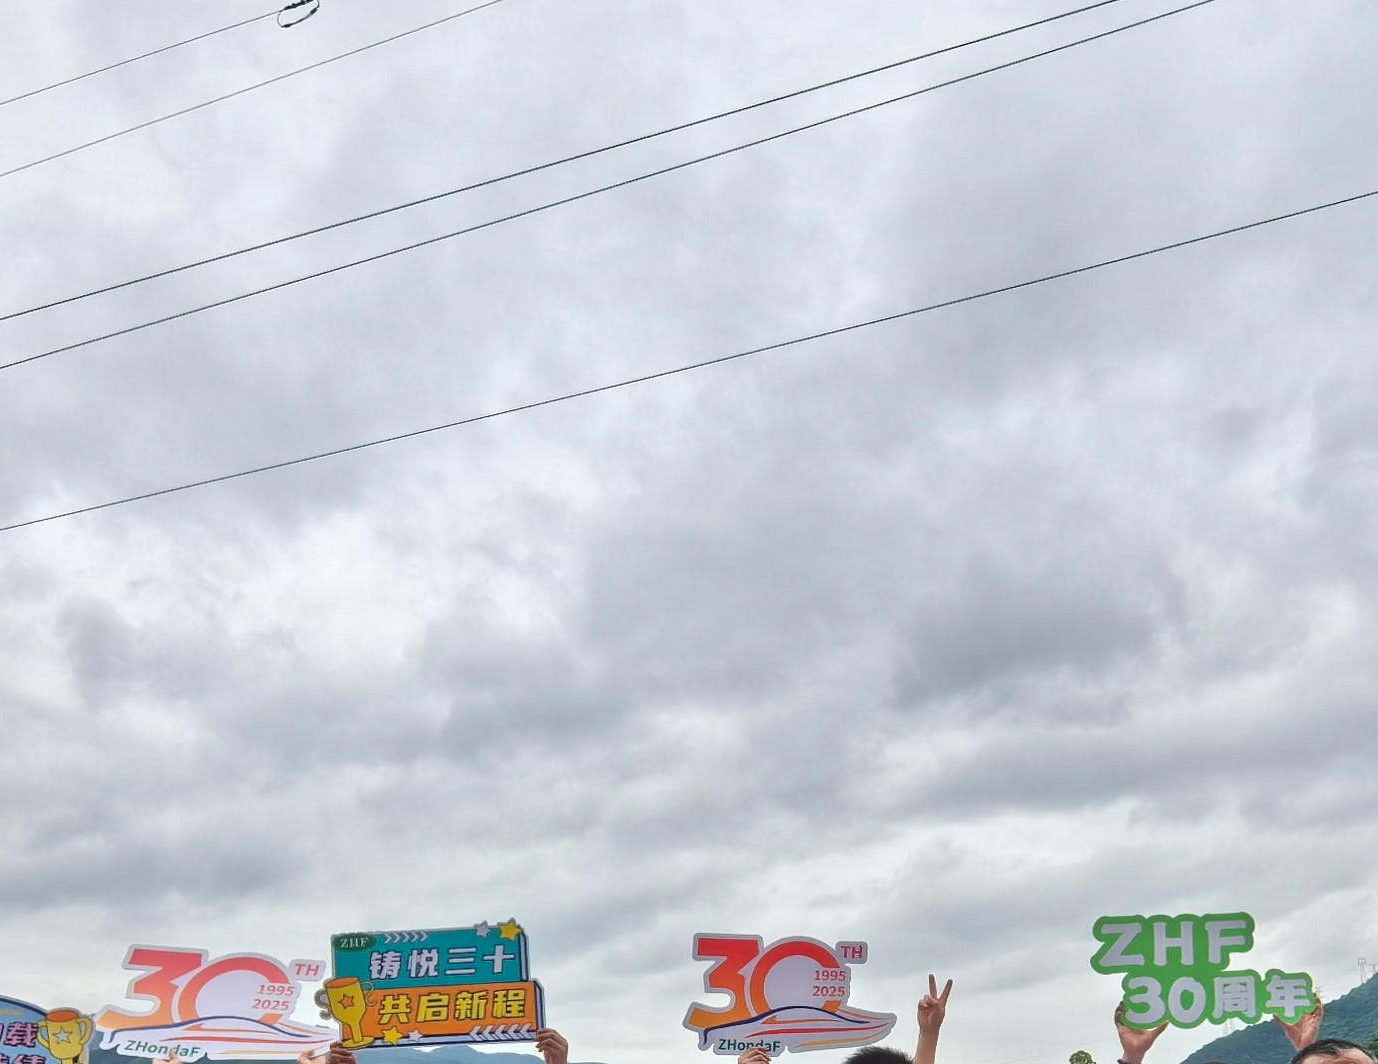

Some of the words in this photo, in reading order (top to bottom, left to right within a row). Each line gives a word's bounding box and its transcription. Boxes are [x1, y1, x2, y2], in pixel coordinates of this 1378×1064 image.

[339, 936, 369, 948] ZHF
[1099, 920, 1247, 967] ZHF
[840, 945, 863, 959] TH
[369, 945, 516, 980] 铸悦三十
[294, 963, 321, 976] TH
[814, 970, 846, 982] 1995
[257, 984, 295, 996] 1995
[812, 986, 845, 997] 2025
[251, 999, 290, 1011] 2025
[1125, 975, 1312, 1024] 30周年
[378, 989, 527, 1025] 共启新程
